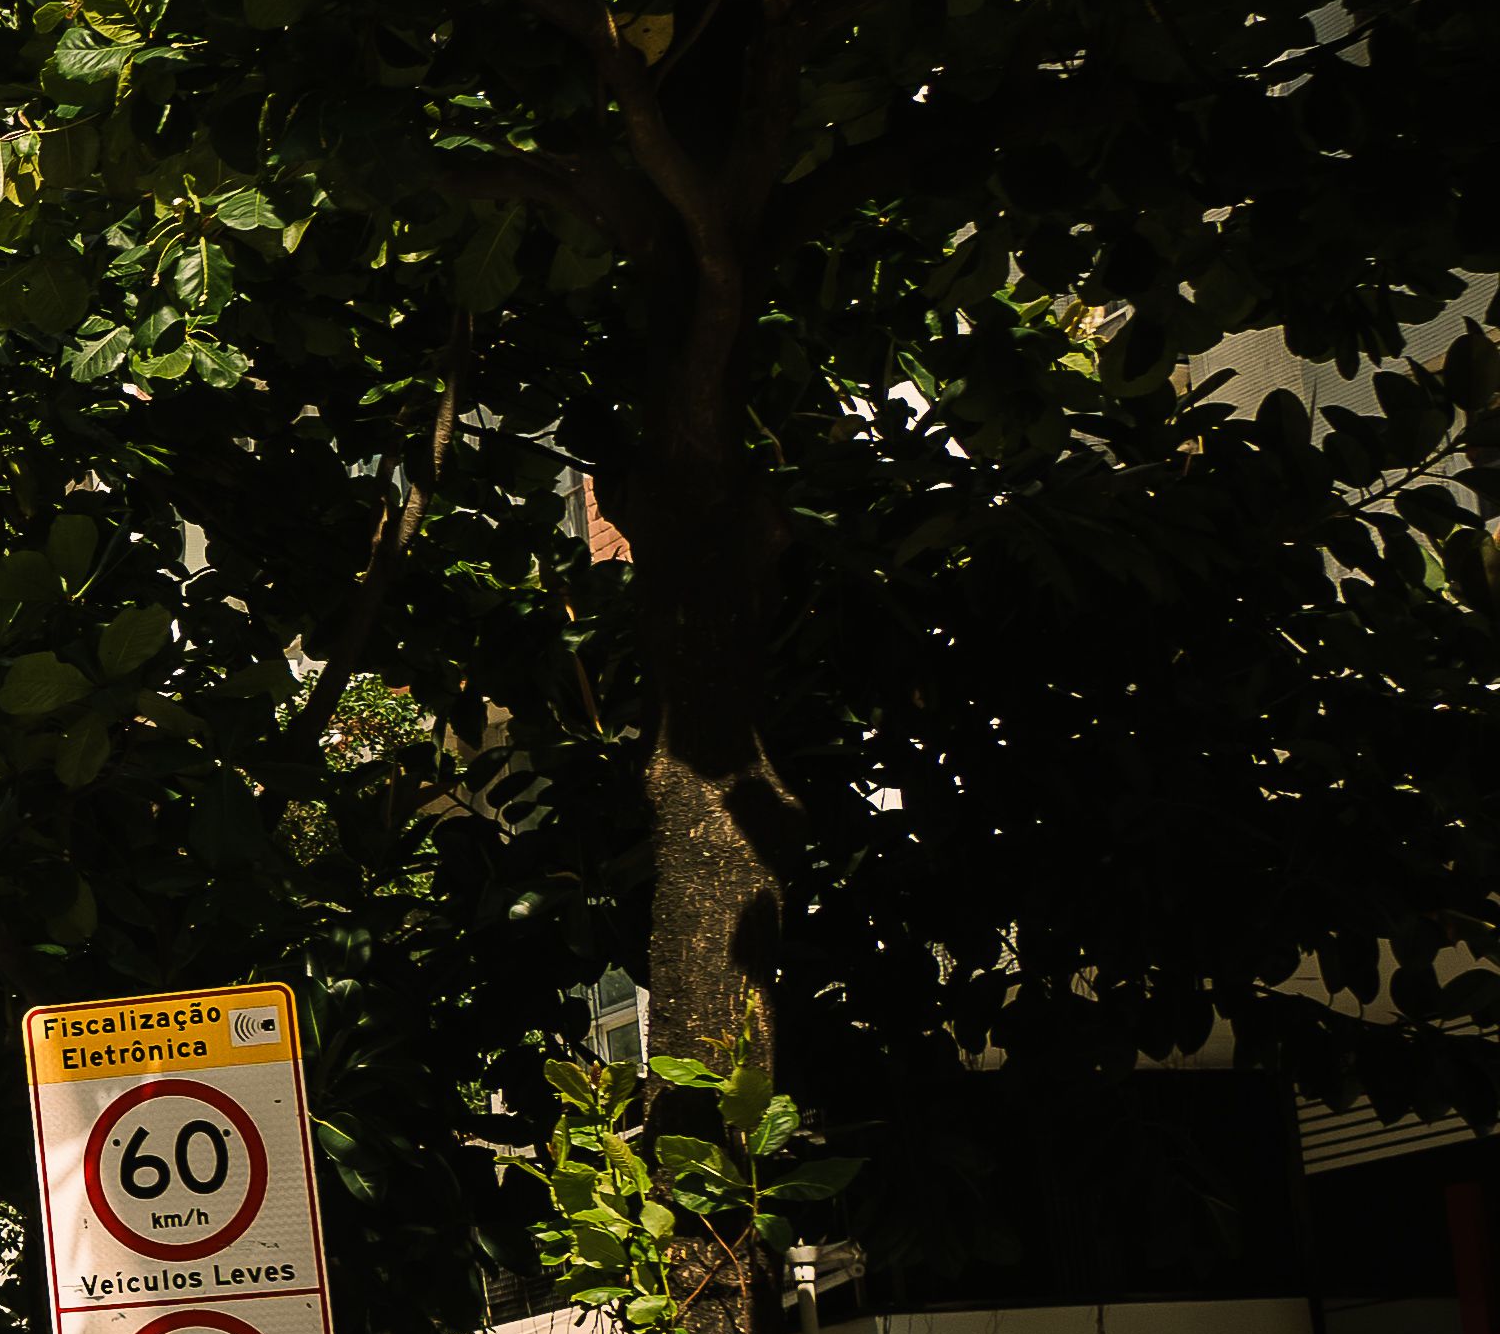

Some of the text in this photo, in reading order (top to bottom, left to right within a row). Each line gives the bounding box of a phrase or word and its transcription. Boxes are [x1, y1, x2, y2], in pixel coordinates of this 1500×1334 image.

[43, 1002, 222, 1040] Fiscalização
[62, 1038, 209, 1070] Eletrônica
[119, 1119, 230, 1201] 60
[151, 1208, 210, 1230] km/h
[81, 1263, 297, 1297] Veículos Leves
